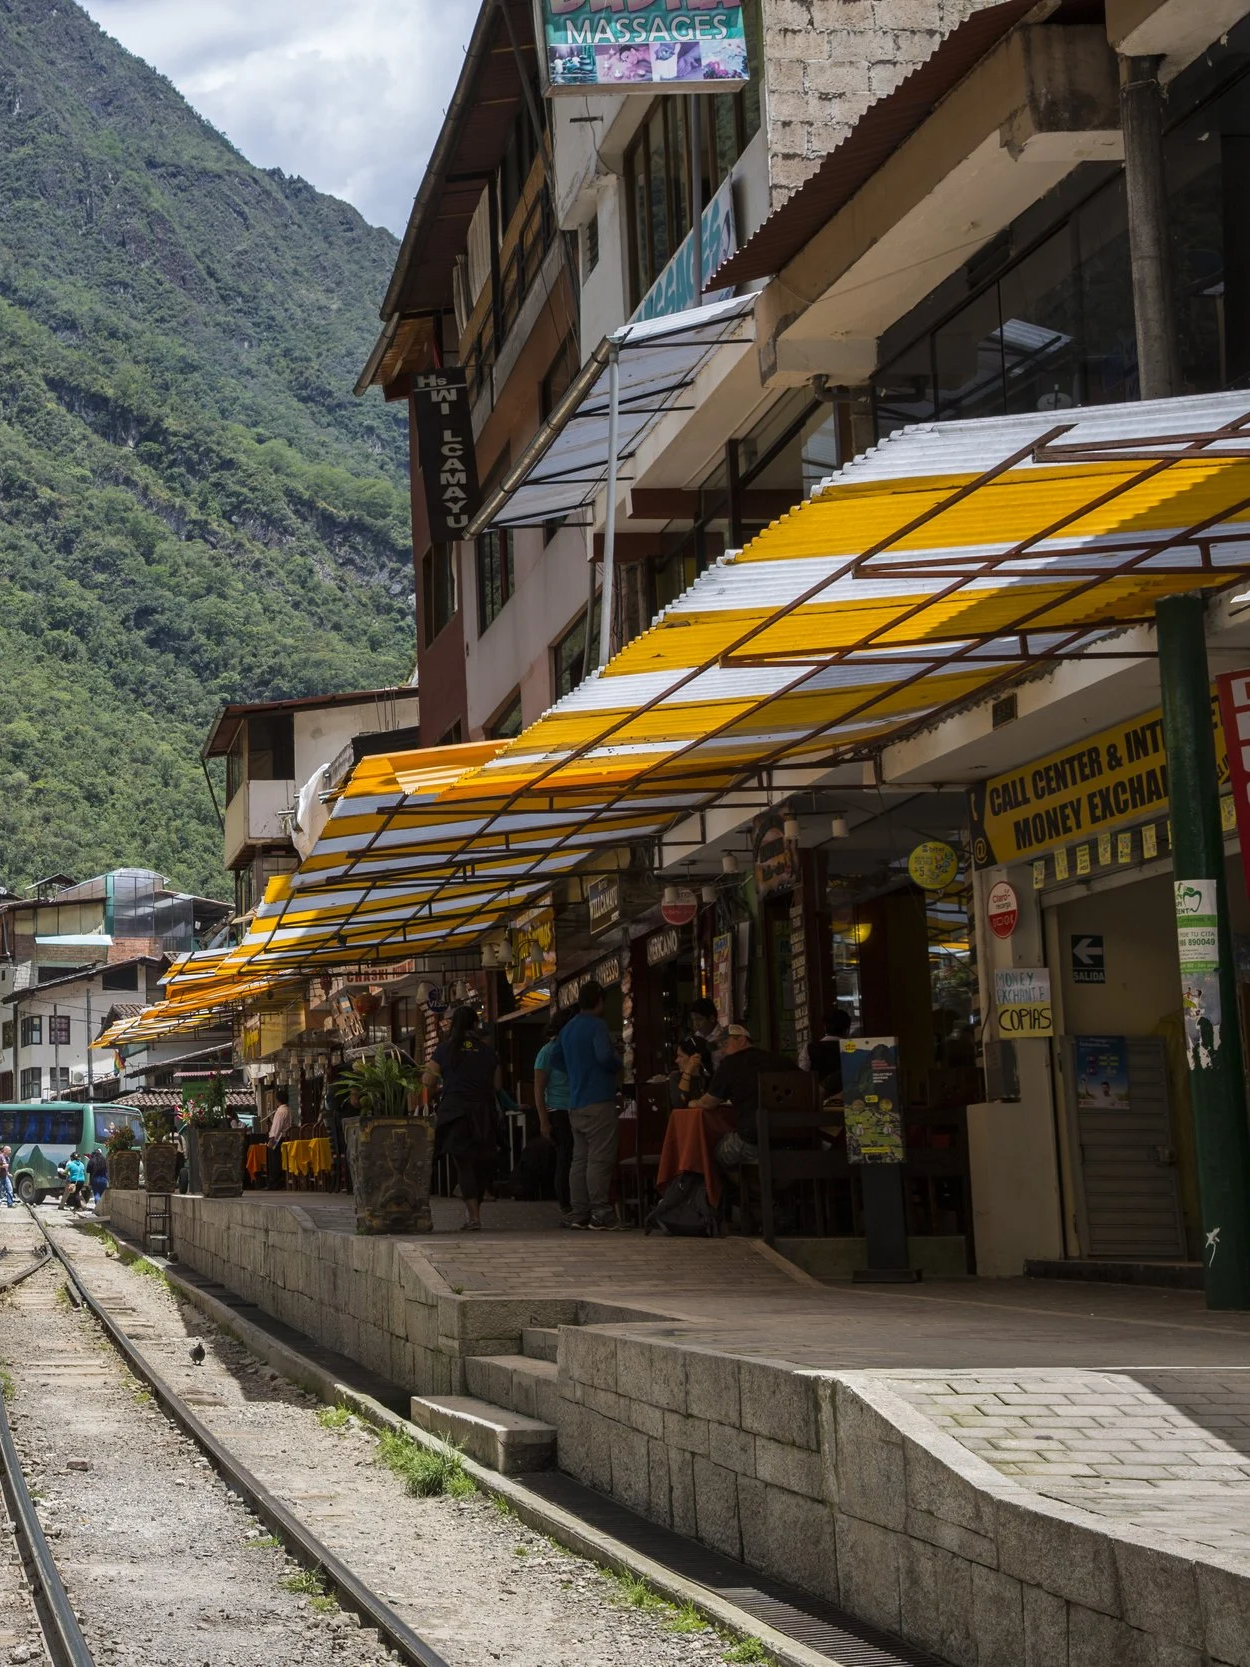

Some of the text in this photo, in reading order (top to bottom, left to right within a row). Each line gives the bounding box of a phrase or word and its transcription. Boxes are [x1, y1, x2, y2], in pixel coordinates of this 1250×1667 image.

[565, 15, 728, 44] MASSAGES
[989, 776, 1031, 817] CALL
[1031, 745, 1103, 801] CENTER
[1105, 743, 1123, 772] &
[1013, 765, 1169, 851] MONEY EXCHA
[992, 893, 1010, 905] Claro
[1188, 938, 1216, 947] 890049
[996, 971, 1034, 987] MONEY
[1073, 970, 1105, 982] SALIDA
[998, 1007, 1052, 1031] COPIAS
